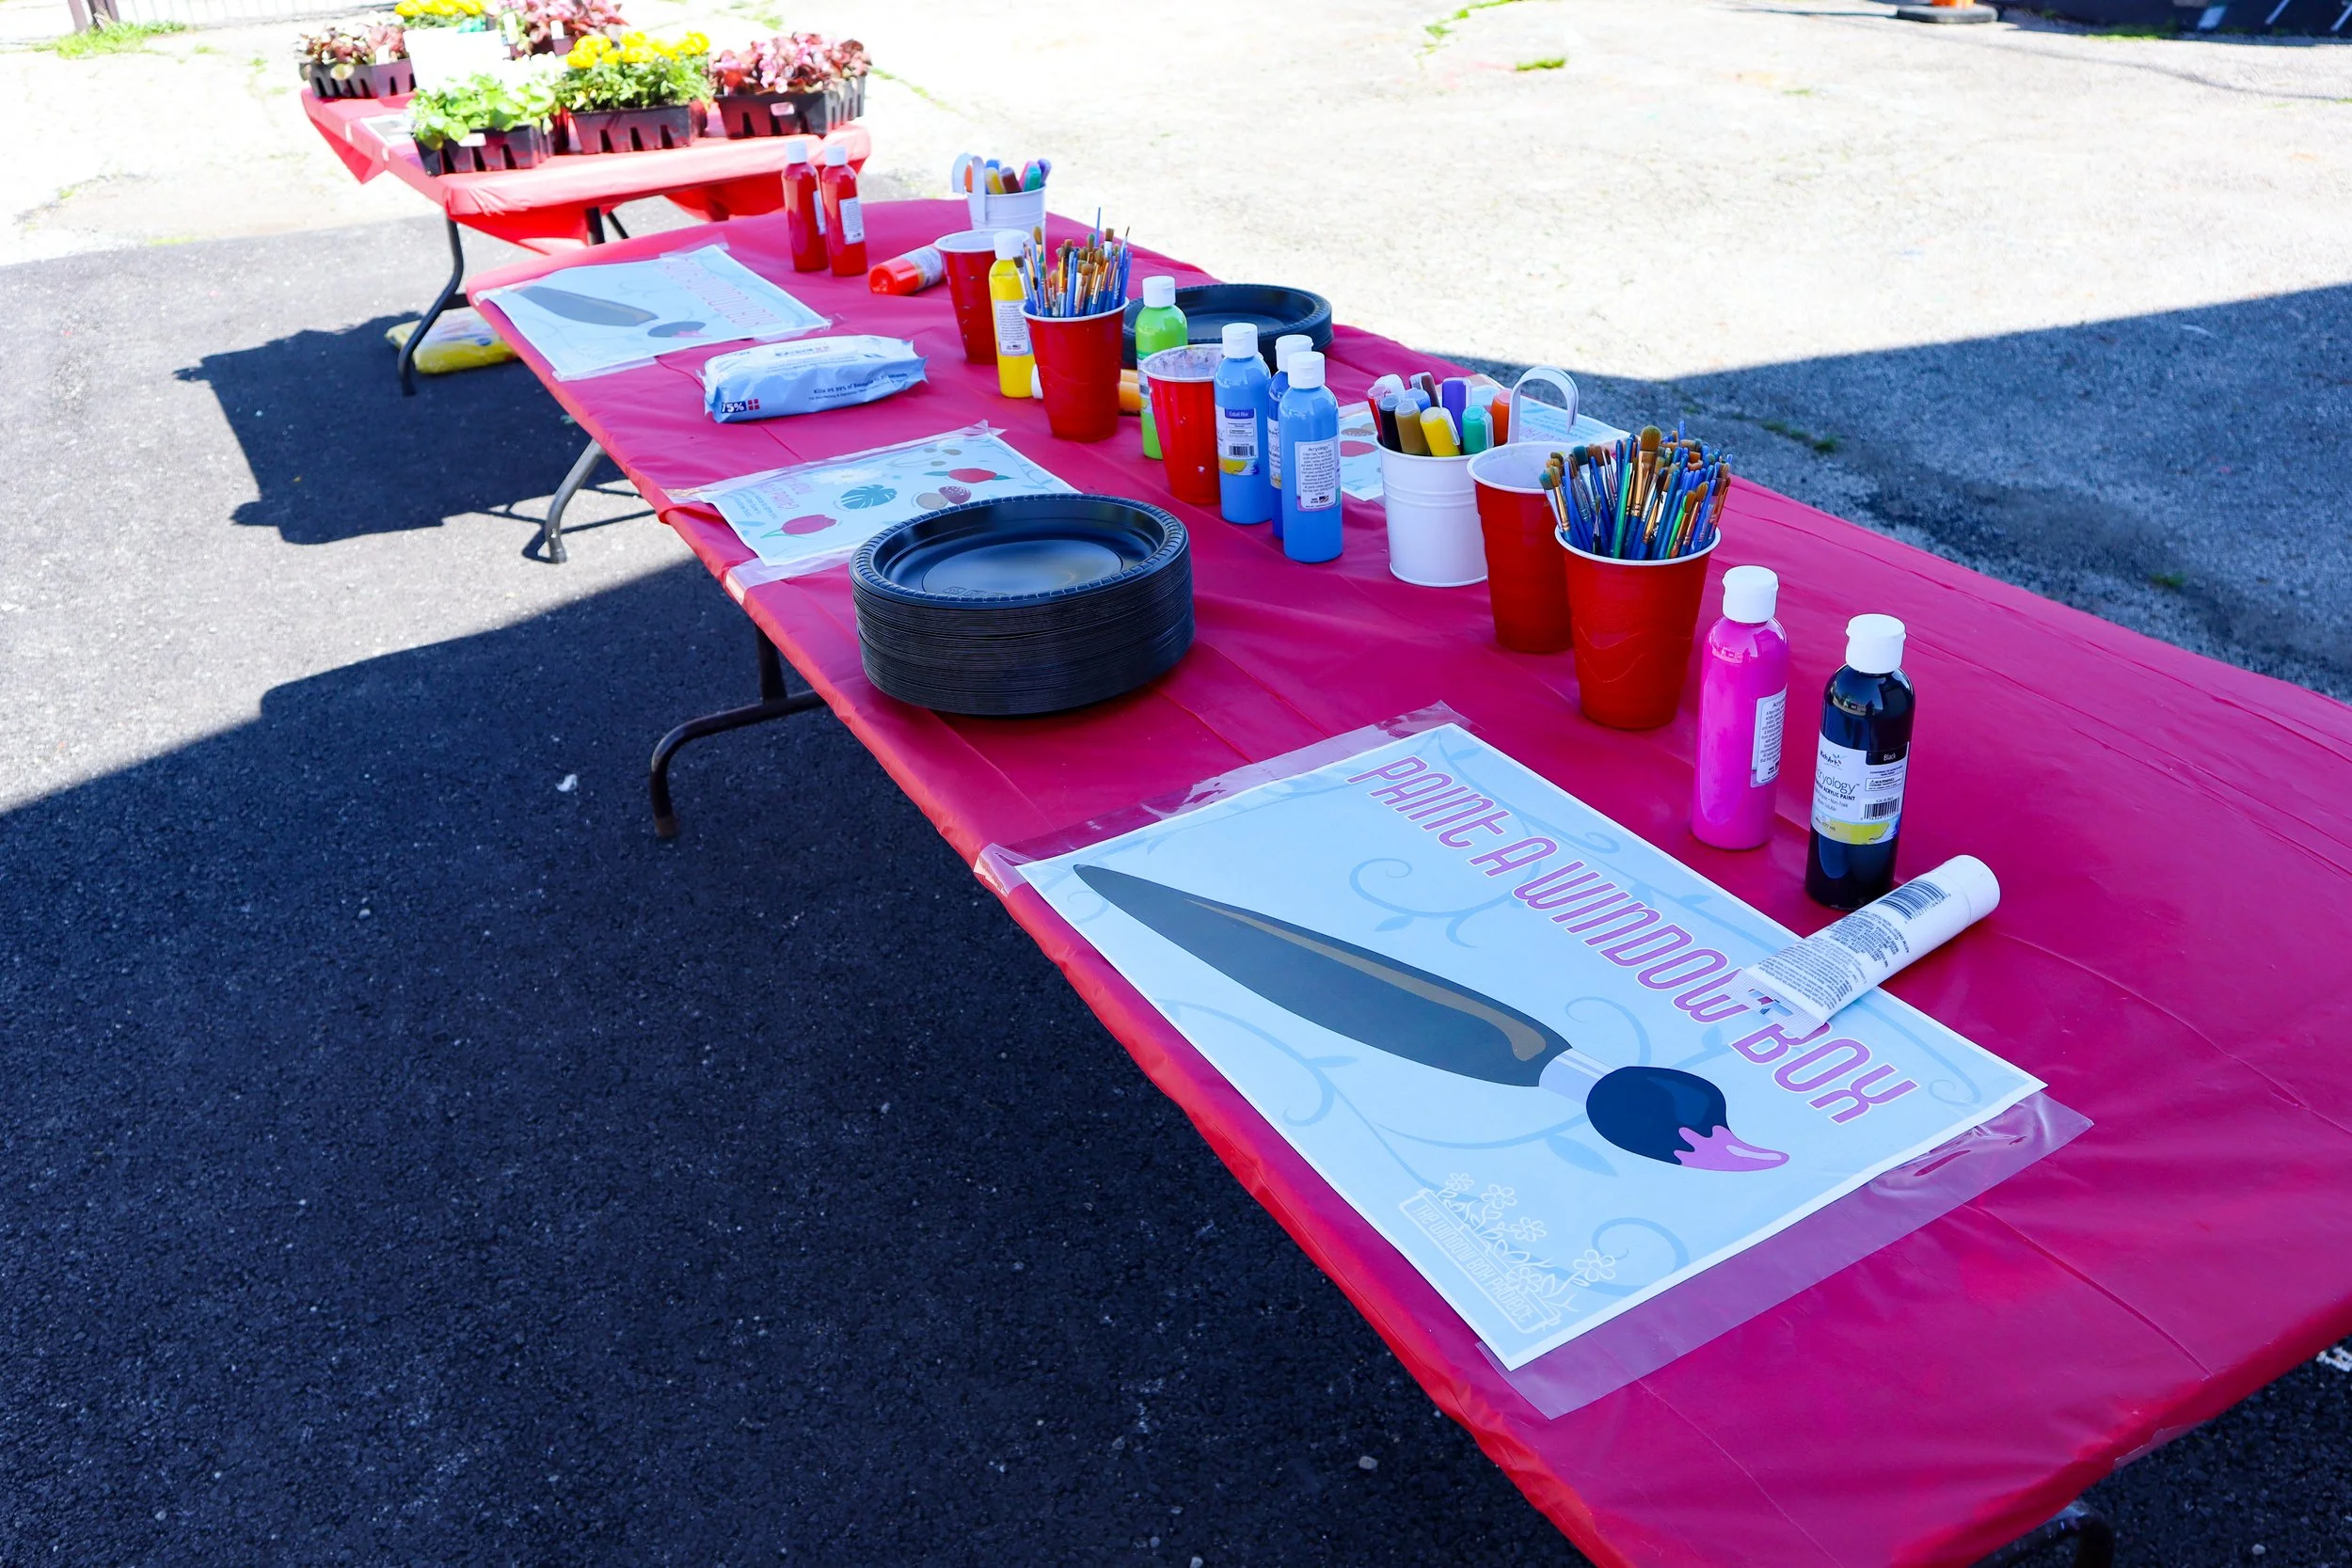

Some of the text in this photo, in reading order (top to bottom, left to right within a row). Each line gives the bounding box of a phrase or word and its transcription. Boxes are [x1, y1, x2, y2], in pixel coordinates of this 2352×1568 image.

[1345, 754, 1511, 850] PAINT
[1823, 787, 1840, 798] ACRYLIC
[1840, 793, 1856, 801] PAINT
[1883, 752, 1897, 762] Black
[1469, 836, 1558, 878] A
[1512, 860, 1772, 1023] WINDOW
[1729, 1021, 1921, 1125] BOX
[1413, 1205, 1535, 1323] THE WINDOW BOX PROJECT
